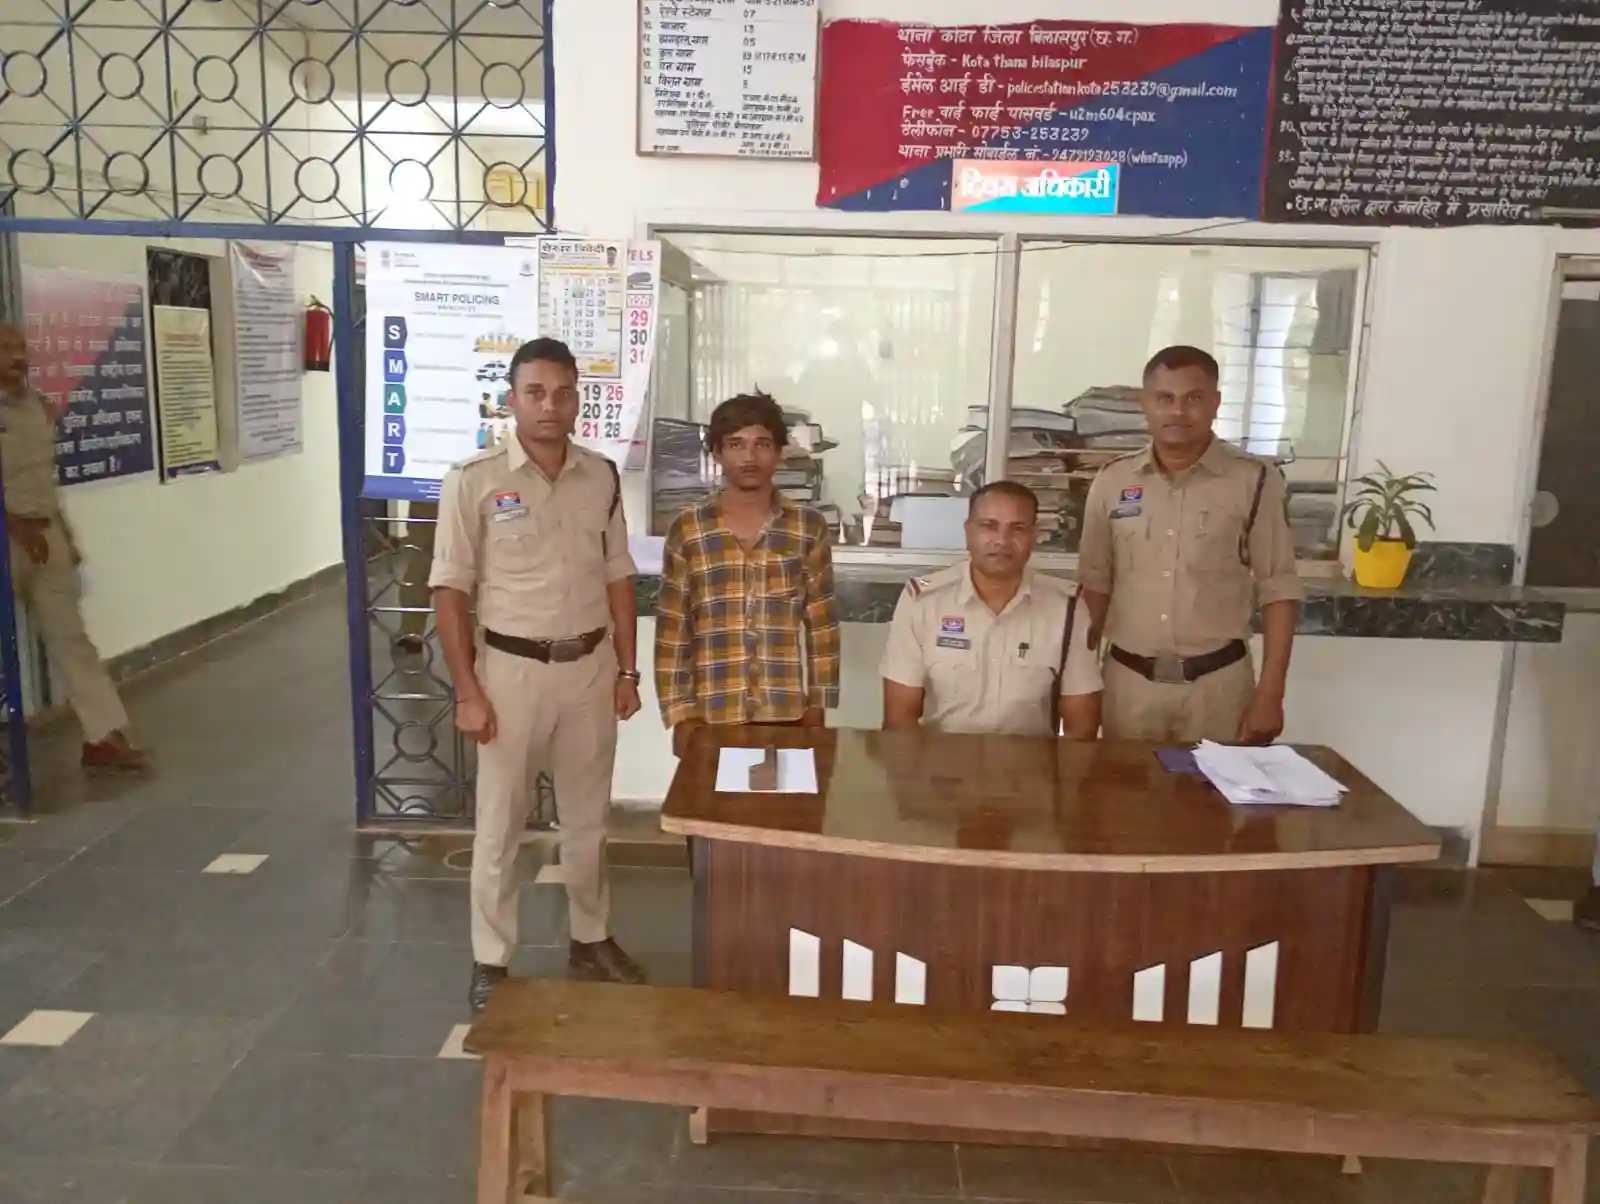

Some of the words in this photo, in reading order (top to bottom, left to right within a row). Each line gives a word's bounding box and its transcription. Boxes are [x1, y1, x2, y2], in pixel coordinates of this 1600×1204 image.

[897, 27, 935, 43] थाना
[940, 26, 977, 43] कोटा
[982, 25, 1023, 45] जिला
[962, 53, 990, 68] Kota
[994, 53, 1028, 69] thana
[1031, 55, 1087, 72] bilaspur
[940, 72, 972, 97] आई
[903, 105, 934, 119] Free
[898, 143, 932, 159] थाना
[935, 142, 970, 159] प्रभारी
[1021, 168, 1111, 199] अधिकारी
[1466, 198, 1527, 219] प्रसारित
[414, 291, 450, 303] SMART
[452, 294, 500, 305] POLICING
[630, 310, 648, 327] 29
[388, 325, 401, 340] S
[630, 329, 648, 346] 30
[630, 349, 645, 364] 31
[388, 359, 404, 374] M
[388, 391, 401, 406] A
[583, 384, 601, 401] 19
[605, 385, 624, 401] 26
[582, 403, 601, 419] 20
[605, 403, 623, 420] 27
[387, 422, 401, 437] R
[582, 422, 599, 438] 21
[604, 422, 620, 438] 28
[386, 452, 399, 467] T
